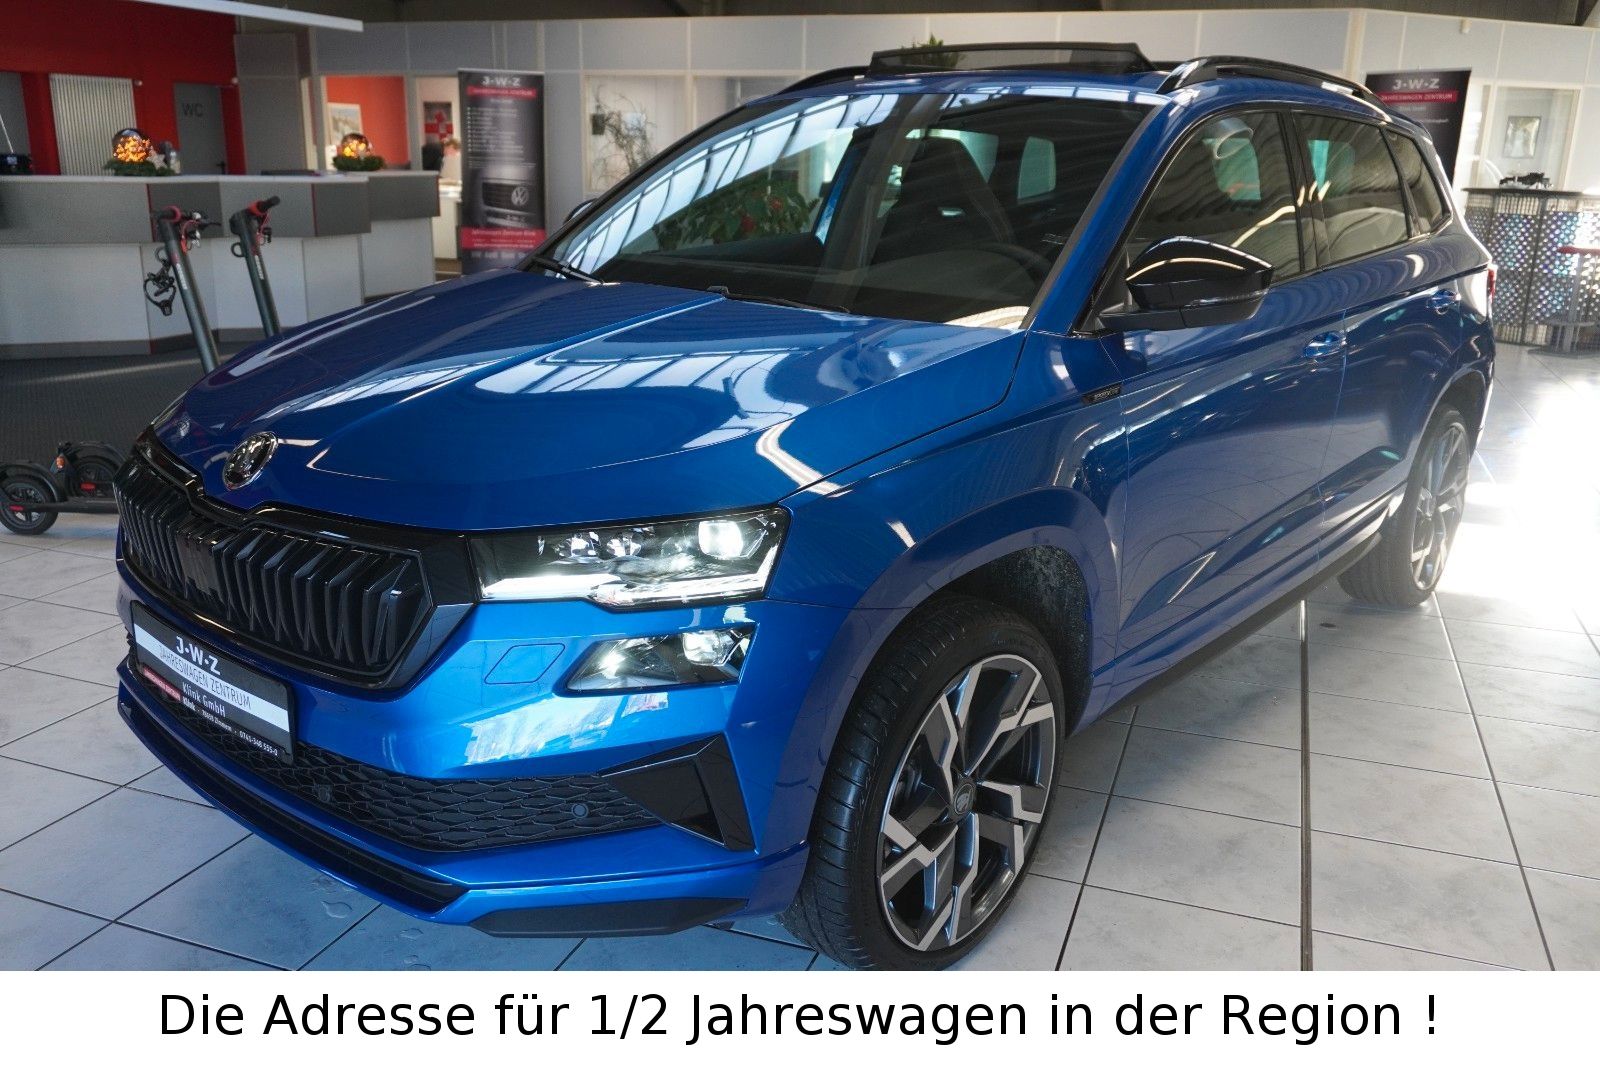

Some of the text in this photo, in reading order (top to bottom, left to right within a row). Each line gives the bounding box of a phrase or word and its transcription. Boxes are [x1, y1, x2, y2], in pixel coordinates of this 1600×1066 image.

[158, 645, 209, 689] JAHRESWAGEN
[211, 677, 252, 711] ZENTRUM
[183, 681, 202, 703] Klink
[203, 694, 226, 718] GmbH
